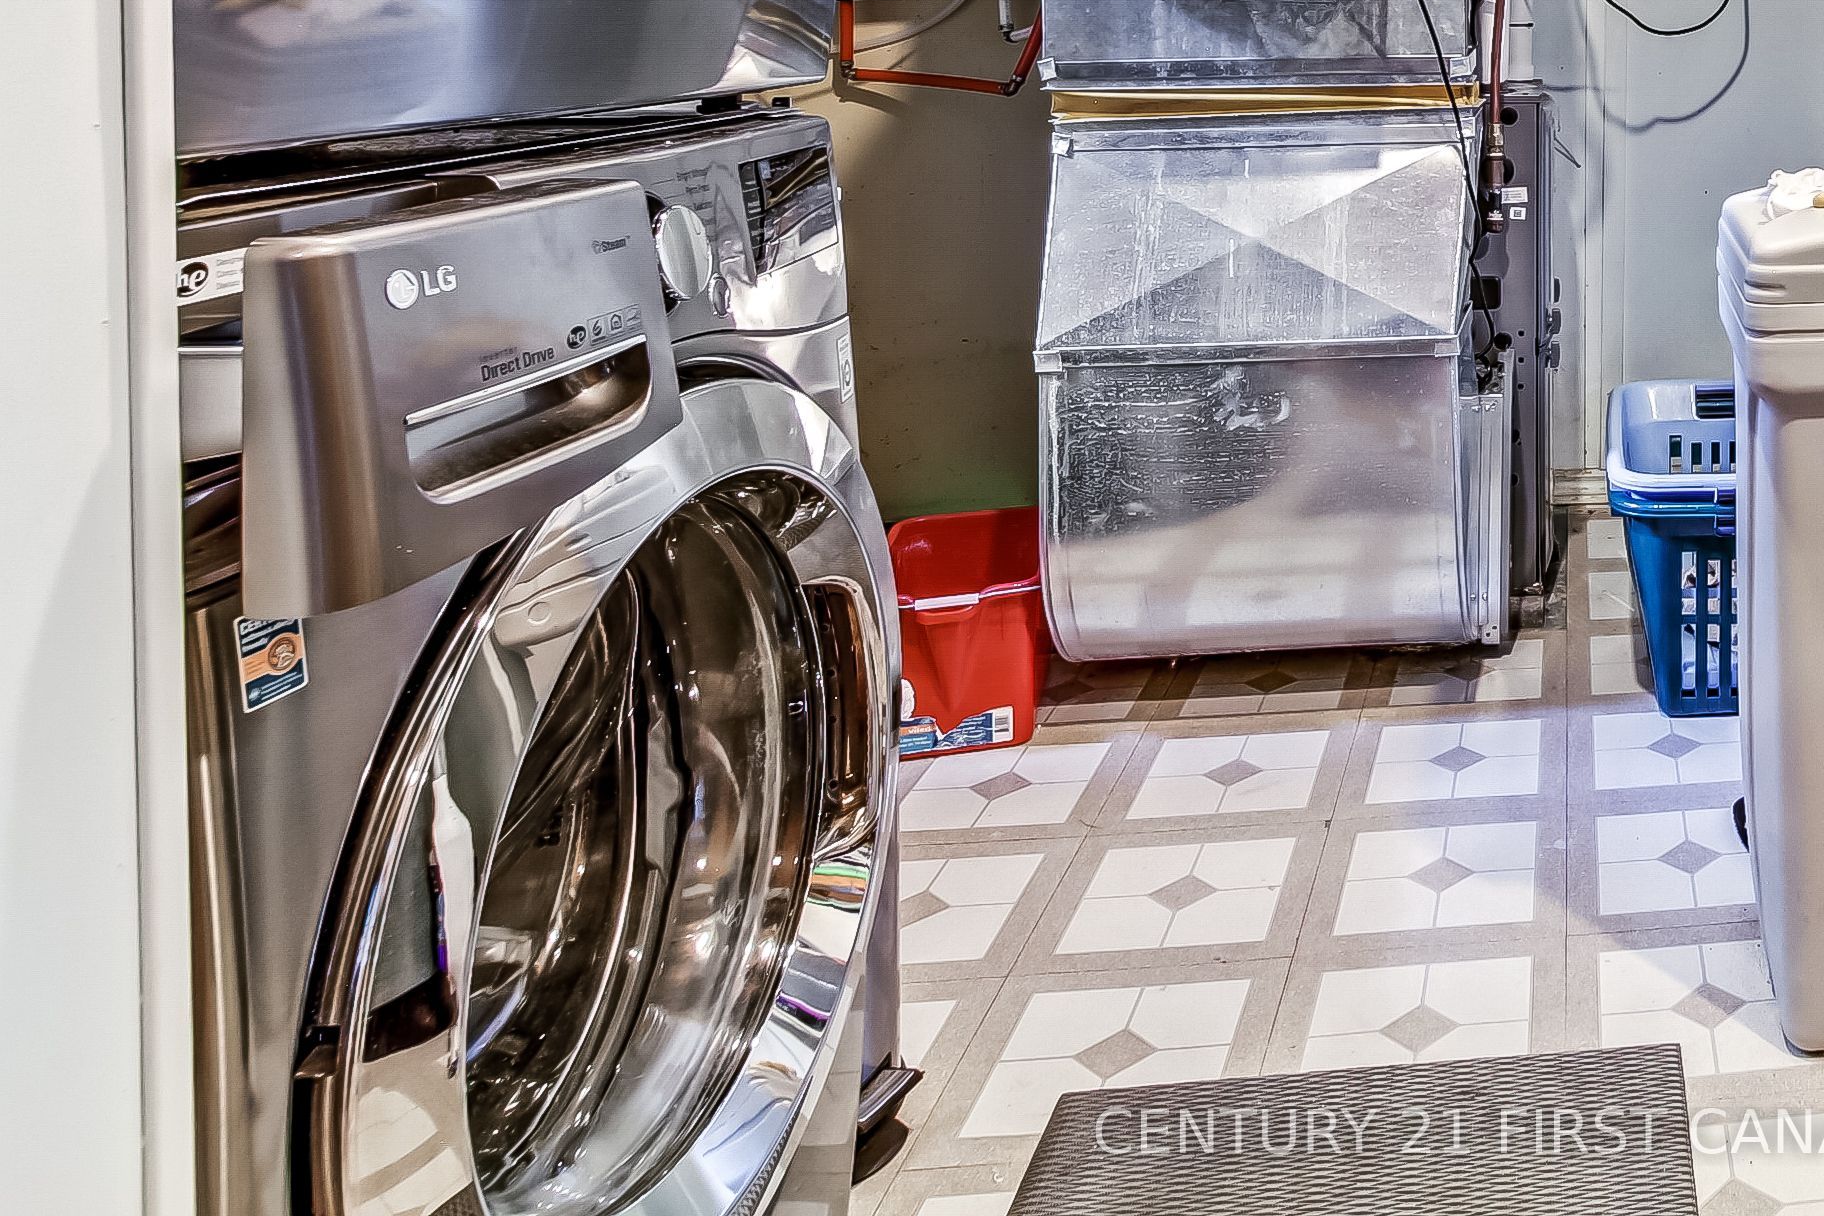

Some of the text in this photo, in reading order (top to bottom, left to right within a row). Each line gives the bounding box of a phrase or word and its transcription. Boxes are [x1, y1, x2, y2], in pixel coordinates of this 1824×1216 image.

[421, 265, 457, 296] LG
[481, 347, 555, 382] Direct Drive
